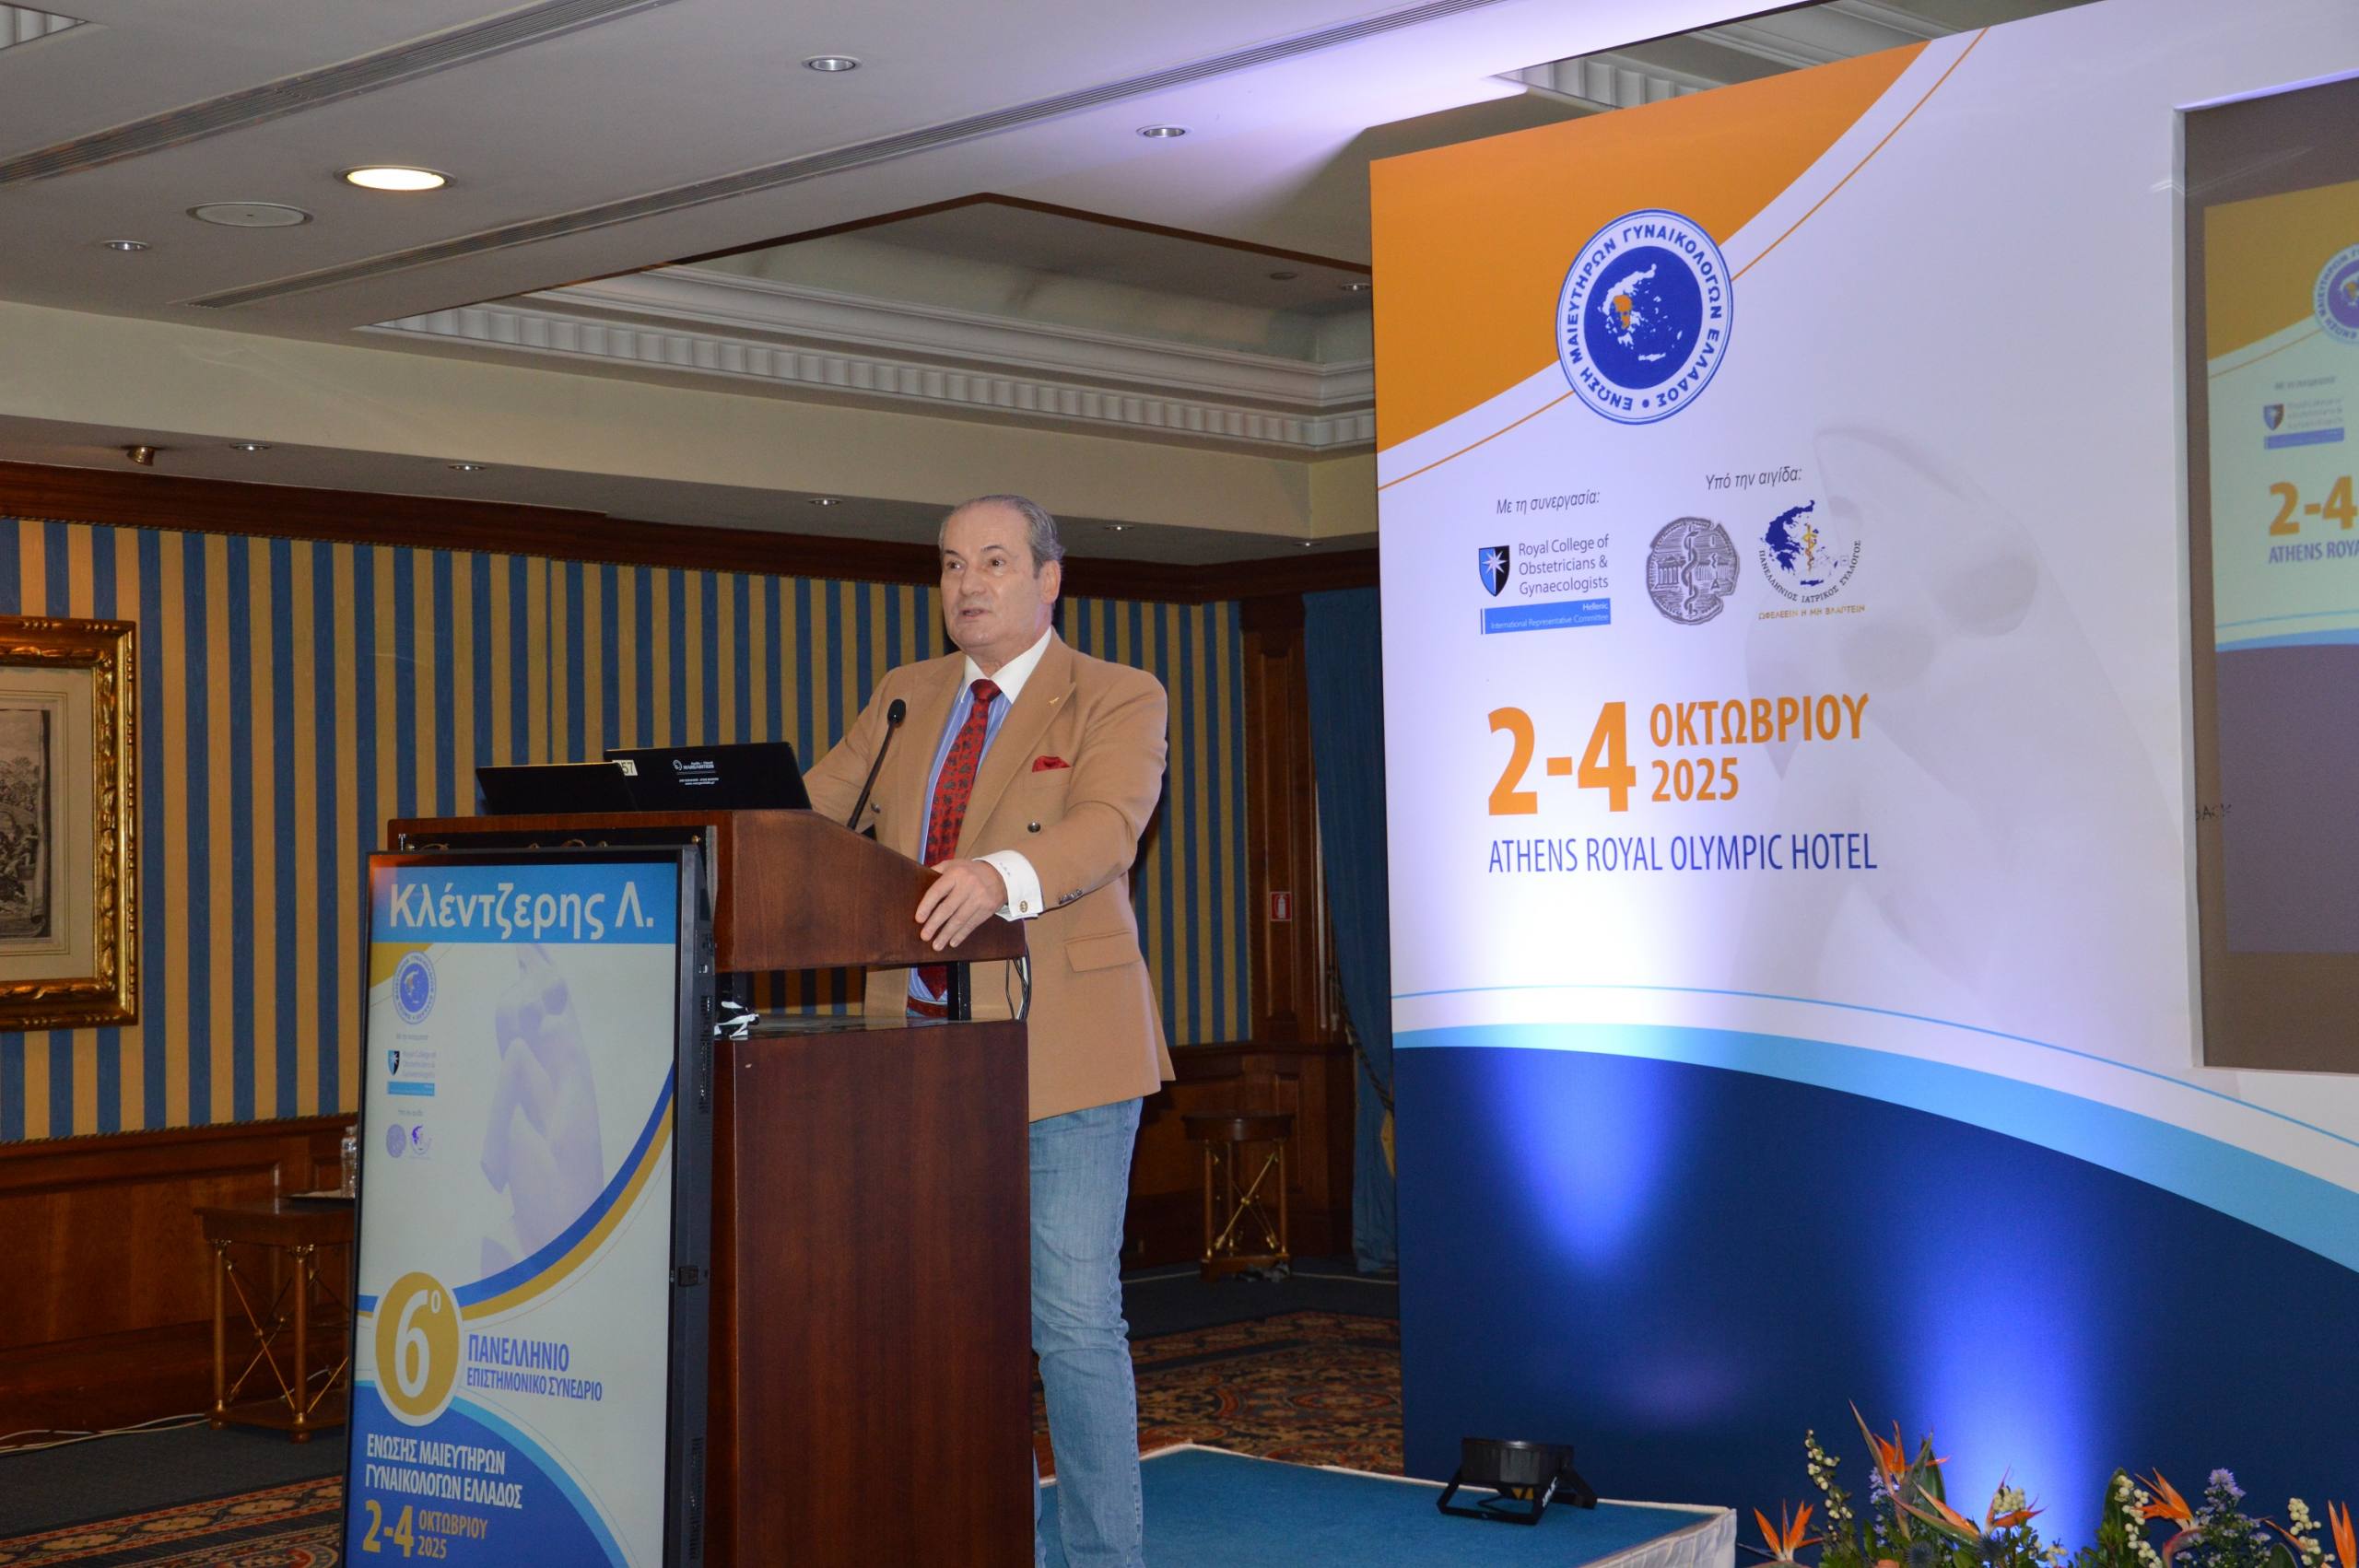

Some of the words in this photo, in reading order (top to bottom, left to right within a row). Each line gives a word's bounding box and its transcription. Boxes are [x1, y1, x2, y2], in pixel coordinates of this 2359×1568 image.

[1623, 224, 1722, 320] ΓΥΝΑΙΚΟΛΟΓΩΝ
[1567, 238, 1616, 364] ΜΑΙΕΥΤΗΡΩΝ
[1580, 367, 1633, 411] ΕΝΩΣΗ
[1656, 329, 1720, 407] ΕΛΛΑΔΟΣ
[1706, 473, 1731, 491] Υπό
[1735, 472, 1755, 490] την
[1758, 466, 1802, 486] αιγίδα:
[1496, 498, 1512, 514] Με
[1516, 499, 1527, 515] τη
[1530, 489, 1601, 511] συνεργασία:
[2270, 474, 2358, 536] 2-4
[1519, 541, 1548, 558] Royal
[1552, 537, 1594, 554] College
[1597, 533, 1609, 548] of
[1519, 558, 1595, 576] Obstetricians
[1599, 555, 1608, 568] &
[2269, 542, 2323, 564] ATHENS
[1520, 577, 1609, 597] Gynaecologists
[1759, 550, 1798, 602] ΠΑΝΕΛΛΗΝΙΟΣ
[1802, 585, 1839, 603] ΙΑΤΡΙΚΟΣ
[1487, 701, 1637, 815] 2-4
[1649, 693, 1869, 747] ΟΚΤΩΒΡΙΟΥ
[1651, 757, 1739, 802] 2025
[1489, 838, 1578, 872] ATHENS
[1587, 837, 1662, 872] ROYAL
[1671, 834, 1783, 871] OLYMPIC
[1791, 833, 1878, 869] HOTEL
[390, 883, 604, 940] Κλέντζερης
[616, 882, 653, 928] Λ.
[468, 1334, 569, 1372] ΠΑΝΕΛΛΗΝΙΟ
[466, 1367, 547, 1396] ΕΠΙΣΤΗΜΟΝΙΚΟ
[548, 1376, 603, 1401] ΣΥΝΕΔΡΙΟ
[367, 1433, 417, 1462] ΕΝΩΣΗΣ
[419, 1440, 505, 1475] ΜΑΙΕΥΤΗΡΩΝ
[365, 1464, 461, 1501] ΓΥΝΑΙΚΟΛΟΓΩΝ
[464, 1478, 523, 1509] ΕΛΛΑΔΟΣ
[362, 1499, 414, 1558] 2-4
[418, 1509, 488, 1539] ΟΚΤΩΒΡΙΟΥ
[417, 1536, 447, 1560] 2025
